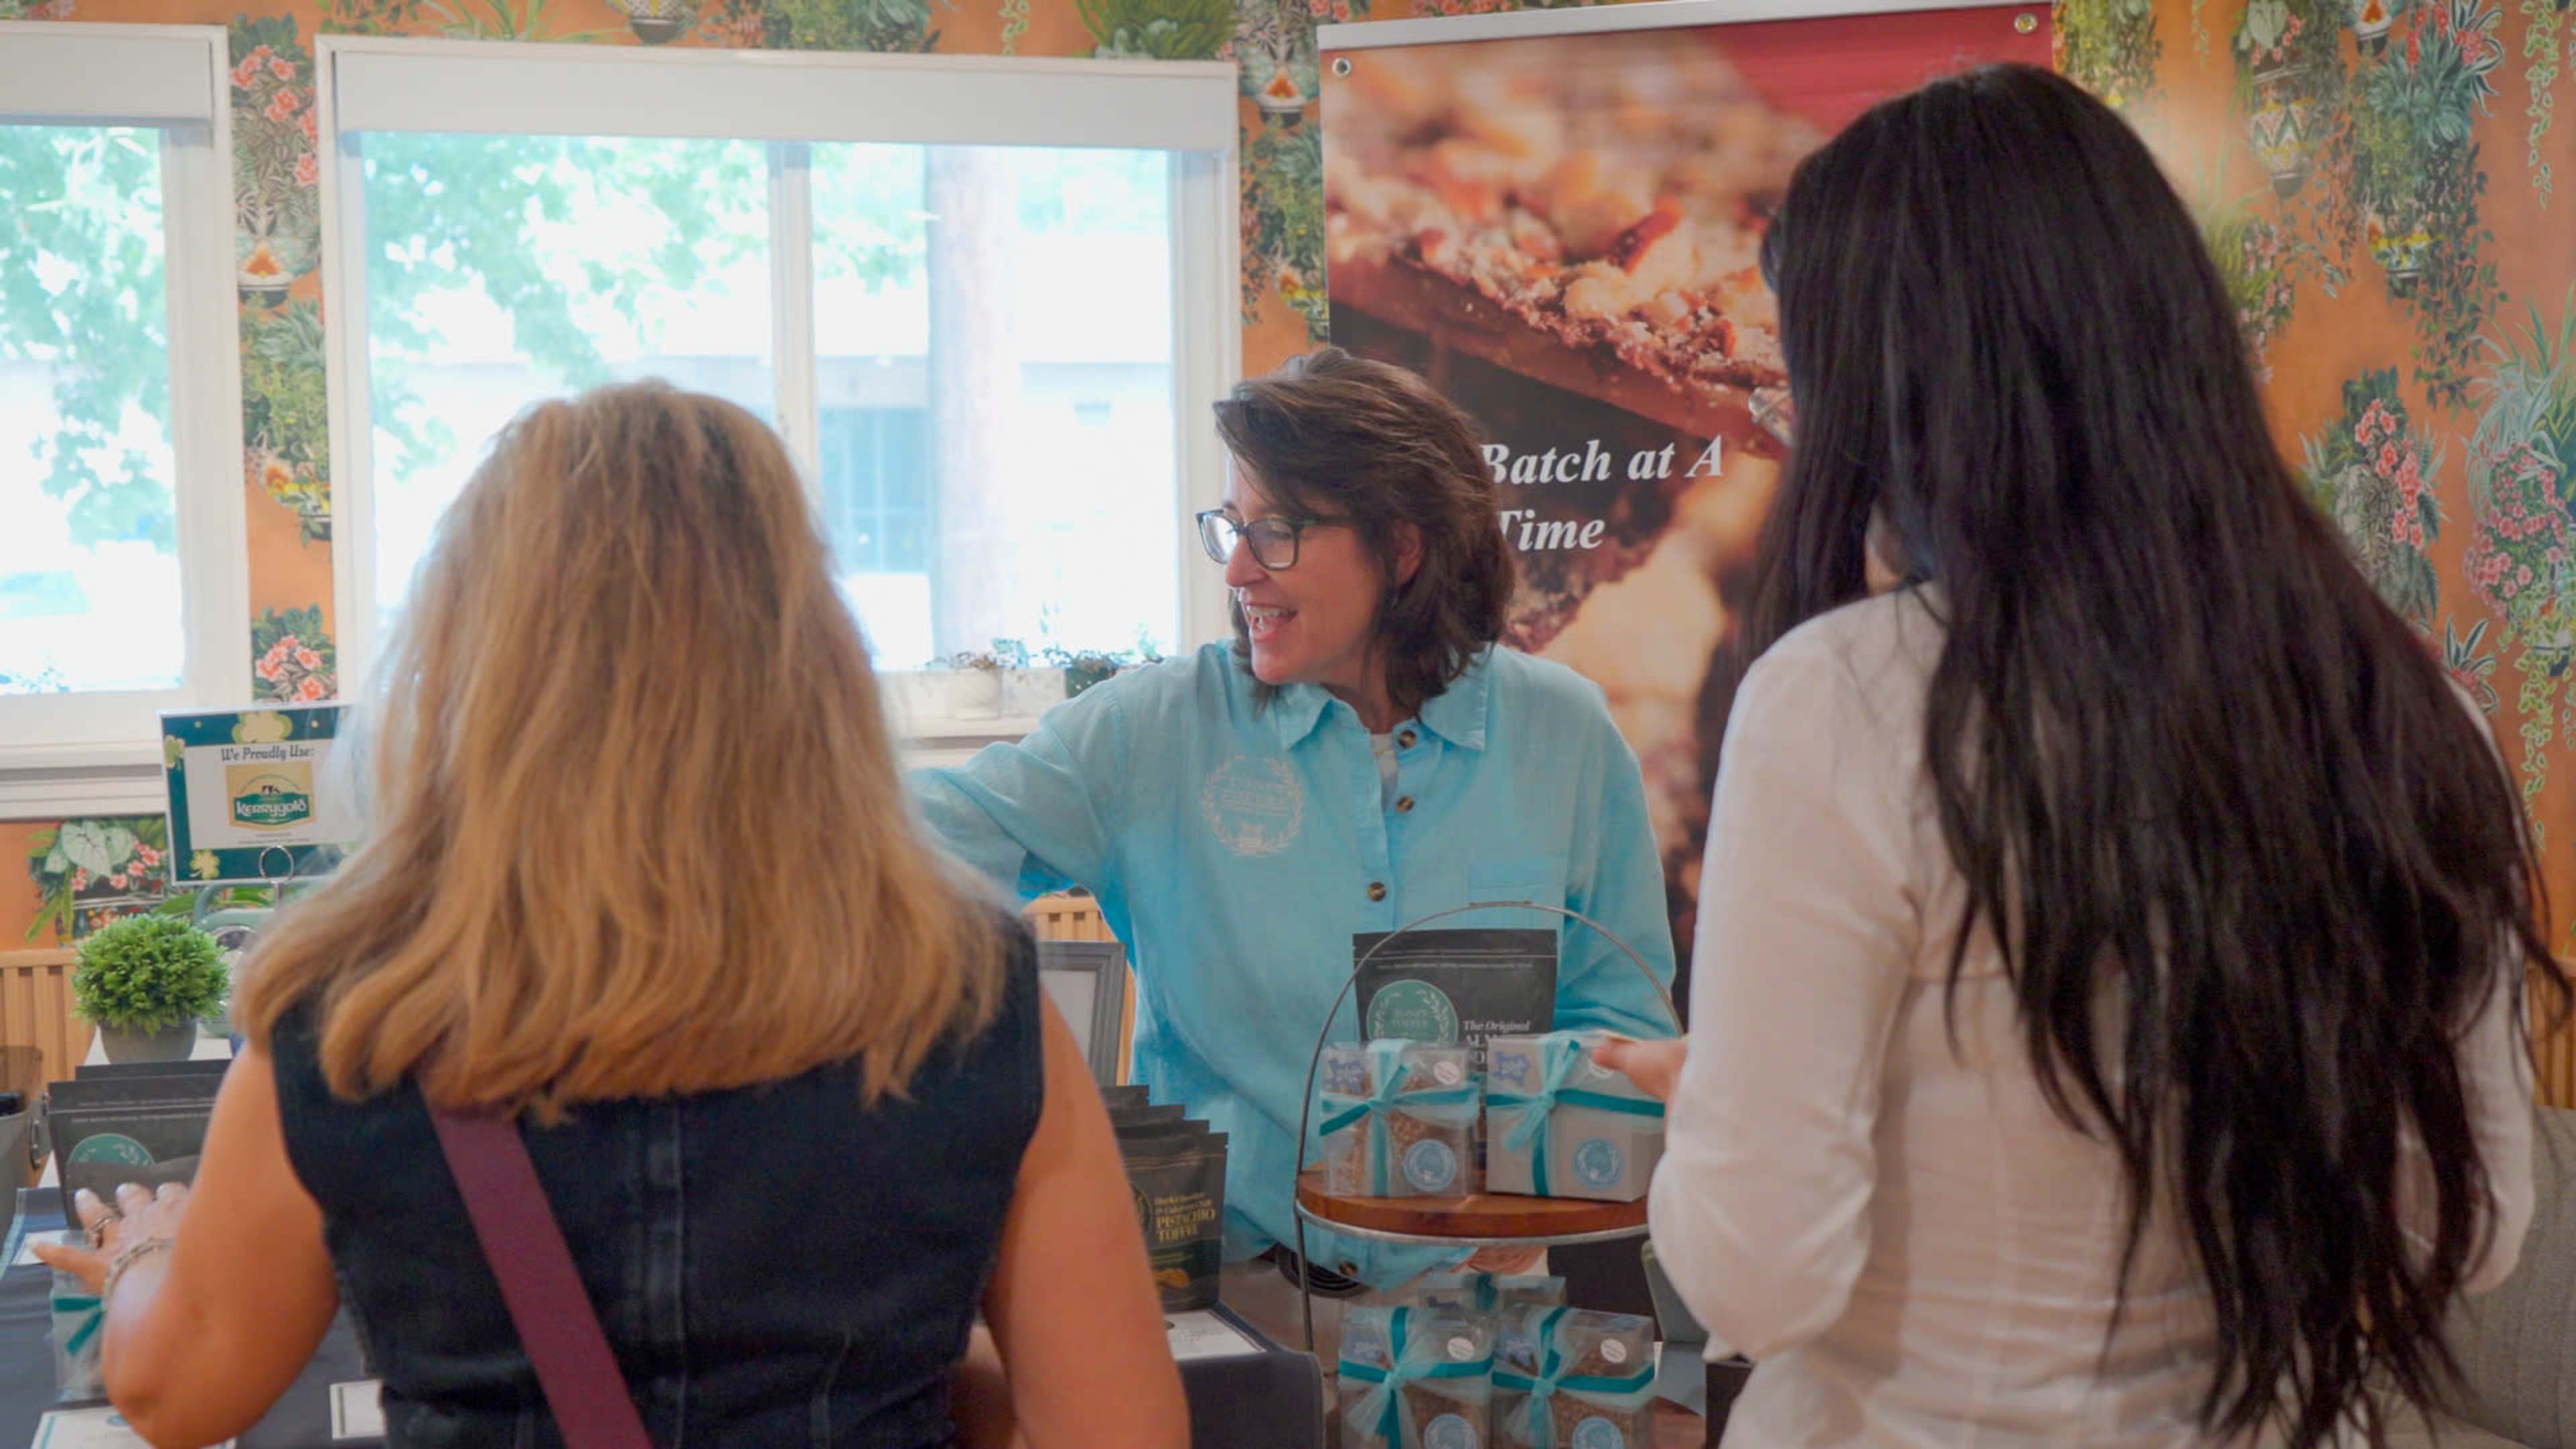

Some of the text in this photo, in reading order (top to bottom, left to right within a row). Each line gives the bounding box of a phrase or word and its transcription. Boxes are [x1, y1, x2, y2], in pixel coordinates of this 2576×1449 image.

[1481, 434, 1724, 484] Batch at A
[1498, 508, 1606, 551] Time
[221, 744, 315, 761] We Proudly Use:
[1462, 1019, 1531, 1033] The Original
[1157, 1208, 1216, 1228] PISTACHIO
